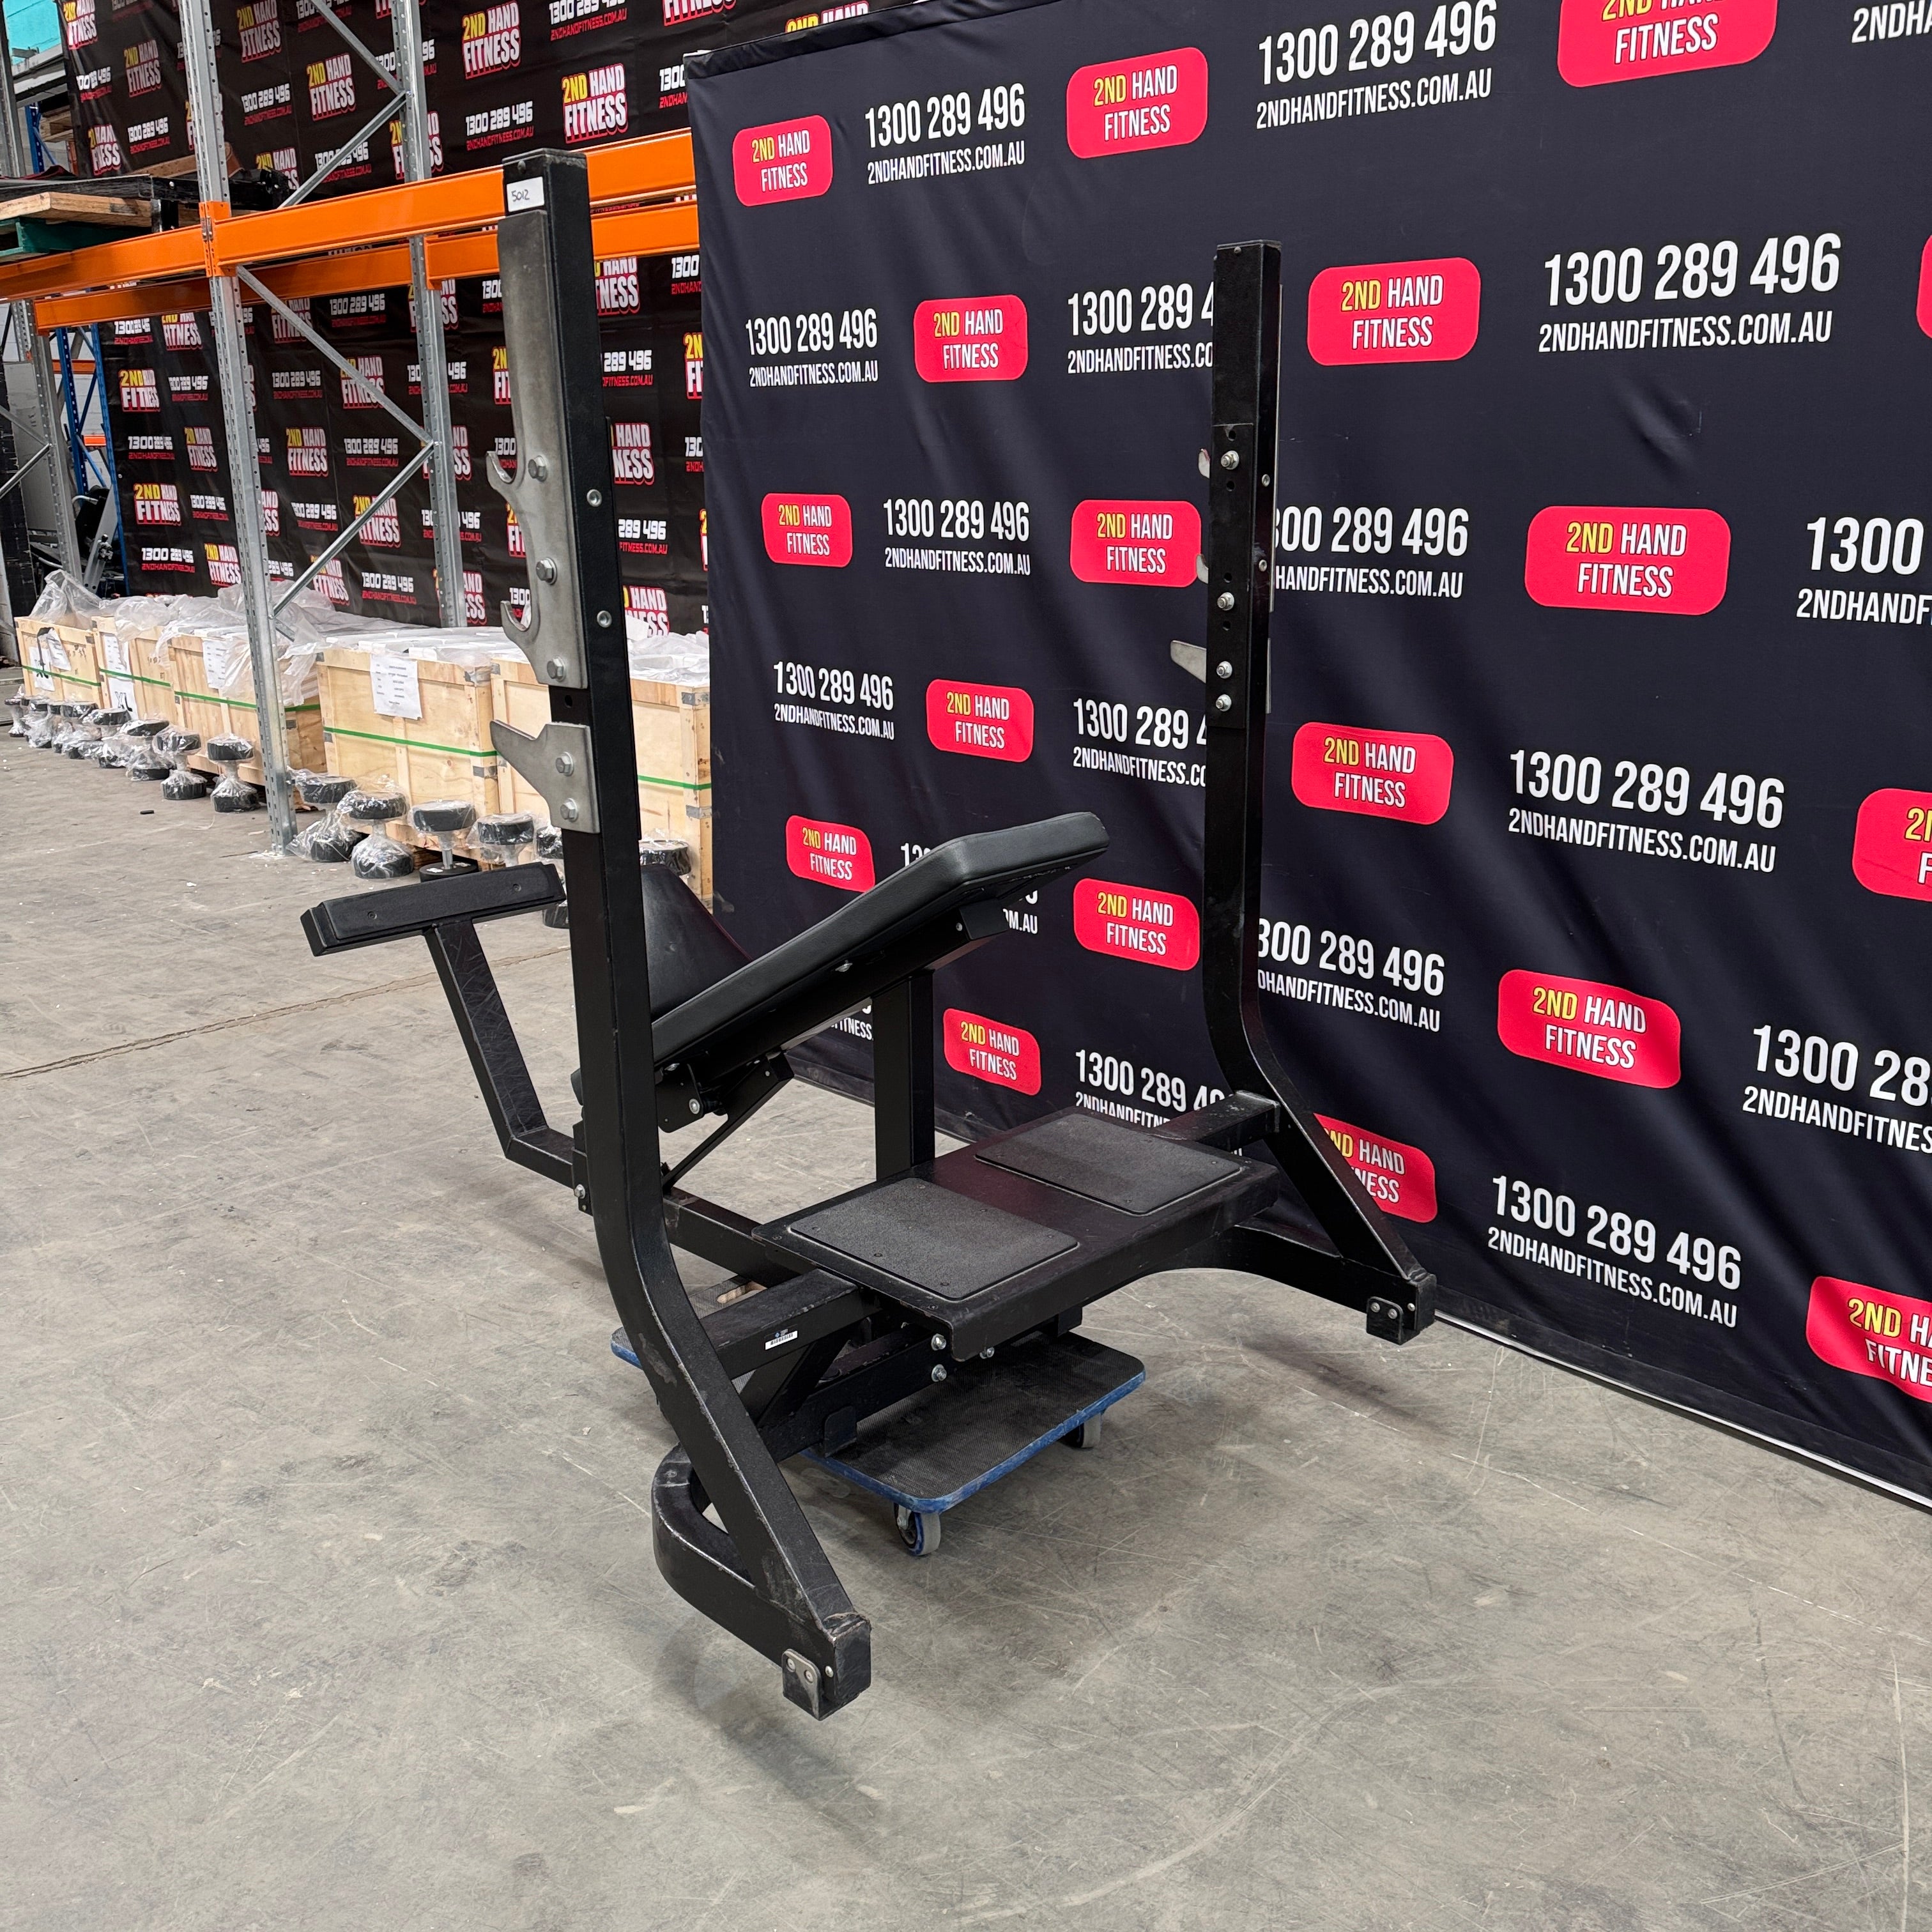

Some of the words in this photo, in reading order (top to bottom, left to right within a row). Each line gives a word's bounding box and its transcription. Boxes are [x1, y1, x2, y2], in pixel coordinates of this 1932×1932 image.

[237, 6, 254, 30] 2ND
[254, 0, 277, 23] HAND
[463, 13, 486, 40] 2ND
[487, 1, 519, 33] HAND
[240, 20, 281, 57] FITNESS
[463, 29, 520, 73] FITNESS
[1259, 24, 1338, 85] 1300
[1348, 11, 1414, 72] 289
[1424, 0, 1497, 58] 496
[1615, 13, 1718, 64] FITNESS
[307, 63, 326, 86] 2ND
[326, 54, 352, 81] HAND
[562, 75, 587, 103] 2ND
[589, 65, 625, 96] HAND
[1094, 75, 1126, 106] 2ND
[1132, 65, 1177, 100] HAND
[310, 77, 355, 117] FITNESS
[565, 93, 627, 137] FITNESS
[864, 100, 921, 148] 1300
[926, 91, 971, 139] 289
[977, 82, 1025, 131] 496
[1256, 67, 1492, 130] 2NDHANDFITNESS.COM.AU
[465, 112, 488, 136] 1300
[490, 107, 510, 130] 289
[512, 101, 533, 125] 496
[1105, 104, 1170, 141] FITNESS
[751, 137, 775, 163] 2ND
[778, 130, 810, 158] HAND
[867, 140, 1025, 185] 2NDHANDFITNESS.COM.AU
[761, 162, 808, 192] FITNESS
[511, 189, 530, 202] 5012
[671, 255, 700, 279] 1300
[1544, 247, 1643, 306] 1300
[1654, 240, 1738, 300] 289
[1749, 233, 1841, 295] 496
[1068, 288, 1132, 336] 1300
[1140, 283, 1193, 332] 289
[1342, 280, 1381, 311] 2ND
[1388, 275, 1443, 308] HAND
[745, 316, 792, 355] 1300
[795, 312, 834, 352] 289
[839, 308, 877, 349] 496
[933, 311, 960, 337] 2ND
[965, 309, 1003, 335] HAND
[1353, 316, 1433, 349] FITNESS
[1538, 310, 1833, 353] 2NDHANDFITNESS.COM.AU
[358, 357, 383, 376] HAND
[604, 352, 626, 372] 289
[629, 350, 652, 371] 496
[749, 360, 878, 387] 2NDHANDFITNESS.COM.AU
[943, 342, 999, 369] FITNESS
[1068, 341, 1213, 374] 2NDHANDFITNESS.CO
[287, 429, 302, 447] 2ND
[302, 429, 326, 447] HAND
[616, 424, 650, 448] HAND
[289, 448, 328, 471] FITNESS
[618, 519, 640, 538] 289
[643, 521, 666, 540] 496
[778, 504, 801, 526] 2ND
[802, 505, 832, 527] HAND
[883, 498, 934, 537] 1300
[940, 500, 985, 539] 289
[990, 501, 1029, 542] 496
[1097, 512, 1126, 539] 2ND
[1131, 514, 1173, 540] HAND
[1331, 507, 1393, 554] 289
[1401, 507, 1469, 556] 496
[786, 532, 830, 556] FITNESS
[1567, 522, 1613, 553] 2ND
[1620, 523, 1687, 556] HAND
[1807, 516, 1924, 575] 1300
[884, 547, 1031, 576] 2NDHANDFITNESS.COM.AU
[1107, 546, 1166, 574] FITNESS
[1275, 565, 1463, 598] HANDFITNESS.COM.AU
[1577, 563, 1673, 597] FITNESS
[630, 587, 666, 610] HAND
[1796, 588, 1932, 625] 2NDHANDF
[773, 661, 816, 699] 1300
[818, 668, 855, 705] 289
[859, 673, 894, 710] 496
[774, 703, 894, 740] 2NDHANDFITNESS.COM.AU
[947, 691, 971, 716] 2ND
[975, 694, 1009, 721] HAND
[1073, 698, 1128, 742] 1300
[1135, 705, 1189, 749] 289
[955, 721, 1005, 749] FITNESS
[1073, 746, 1206, 787] 2NDHANDFITNESS.C
[1324, 737, 1359, 765] 2ND
[1365, 742, 1416, 774] HAND
[1335, 772, 1406, 808] FITNESS
[1510, 749, 1602, 804] 1300
[1611, 760, 1690, 816] 289
[1699, 772, 1784, 829] 496
[802, 827, 821, 849] 2ND
[824, 832, 857, 855] HAND
[1508, 808, 1776, 873] 2NDHANDFITNESS.COM.AU
[809, 853, 853, 880] FITNESS
[1098, 892, 1127, 917] 2ND
[1132, 898, 1174, 926] HAND
[1107, 922, 1167, 955] FITNESS
[1258, 917, 1311, 965] 300
[1319, 930, 1374, 979] 289
[1383, 946, 1445, 996] 496
[1257, 969, 1440, 1032] DHANDFITNESS.COM.AU
[1533, 987, 1578, 1020] 2ND
[1584, 995, 1646, 1033] HAND
[960, 1021, 986, 1045] 2ND
[988, 1029, 1020, 1056] HAND
[1545, 1024, 1636, 1069] FITNESS
[969, 1048, 1016, 1080] FITNESS
[1075, 1049, 1134, 1096] 1300
[1140, 1067, 1186, 1112] 289
[1753, 1025, 1859, 1091] 1300
[1869, 1050, 1931, 1107] 28
[1324, 1128, 1353, 1158] ND
[1359, 1139, 1404, 1174] HAND
[1351, 1167, 1399, 1203] NESS
[1492, 1175, 1575, 1237] 1300
[1586, 1205, 1656, 1263] 289
[1666, 1231, 1741, 1290] 496
[1488, 1227, 1737, 1328] 2NDHANDFITNESS.COM.AU
[1848, 1298, 1901, 1337] 2ND
